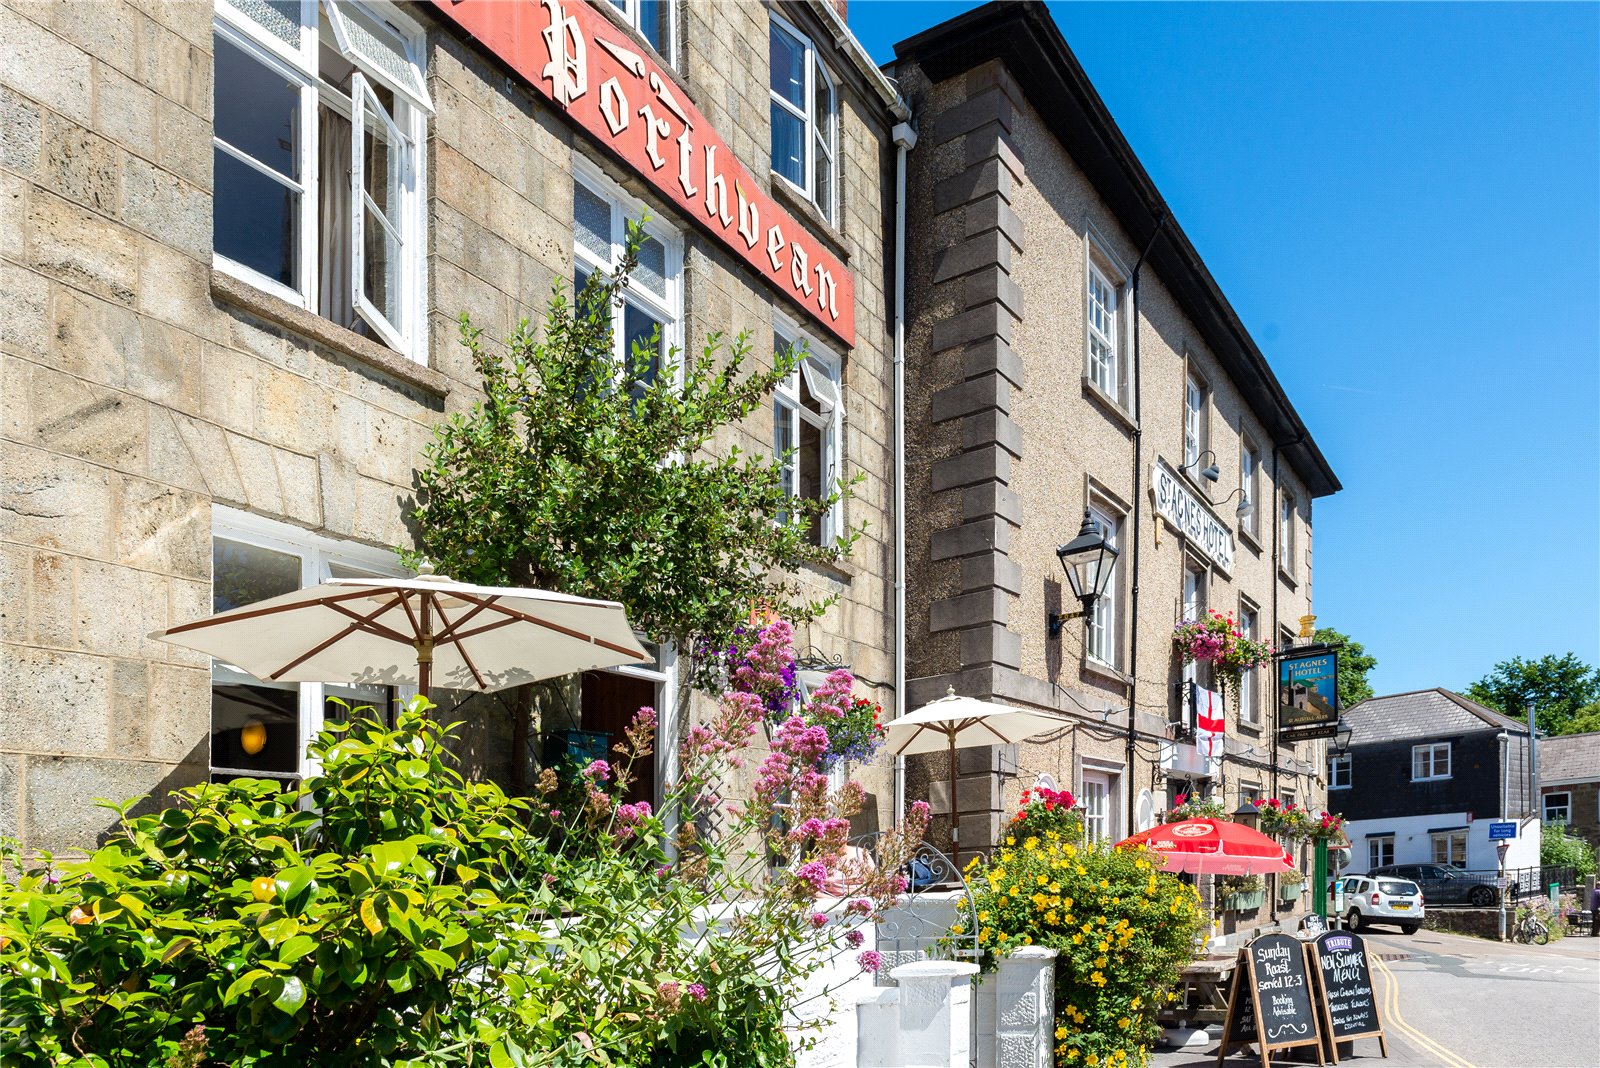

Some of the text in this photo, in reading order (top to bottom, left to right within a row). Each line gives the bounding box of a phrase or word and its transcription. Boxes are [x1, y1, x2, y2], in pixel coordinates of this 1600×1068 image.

[541, 0, 839, 320] Porthvean
[1171, 484, 1201, 536] AGNES
[1204, 514, 1229, 564] HOTEL
[1289, 659, 1327, 671] ST AGNES
[1295, 668, 1321, 677] HOTEL
[1327, 938, 1351, 948] TRIBUTE
[1257, 942, 1291, 964] Sunday
[1265, 960, 1291, 977] Roast
[1333, 968, 1361, 984] MENU
[1272, 994, 1293, 1006] Booking
